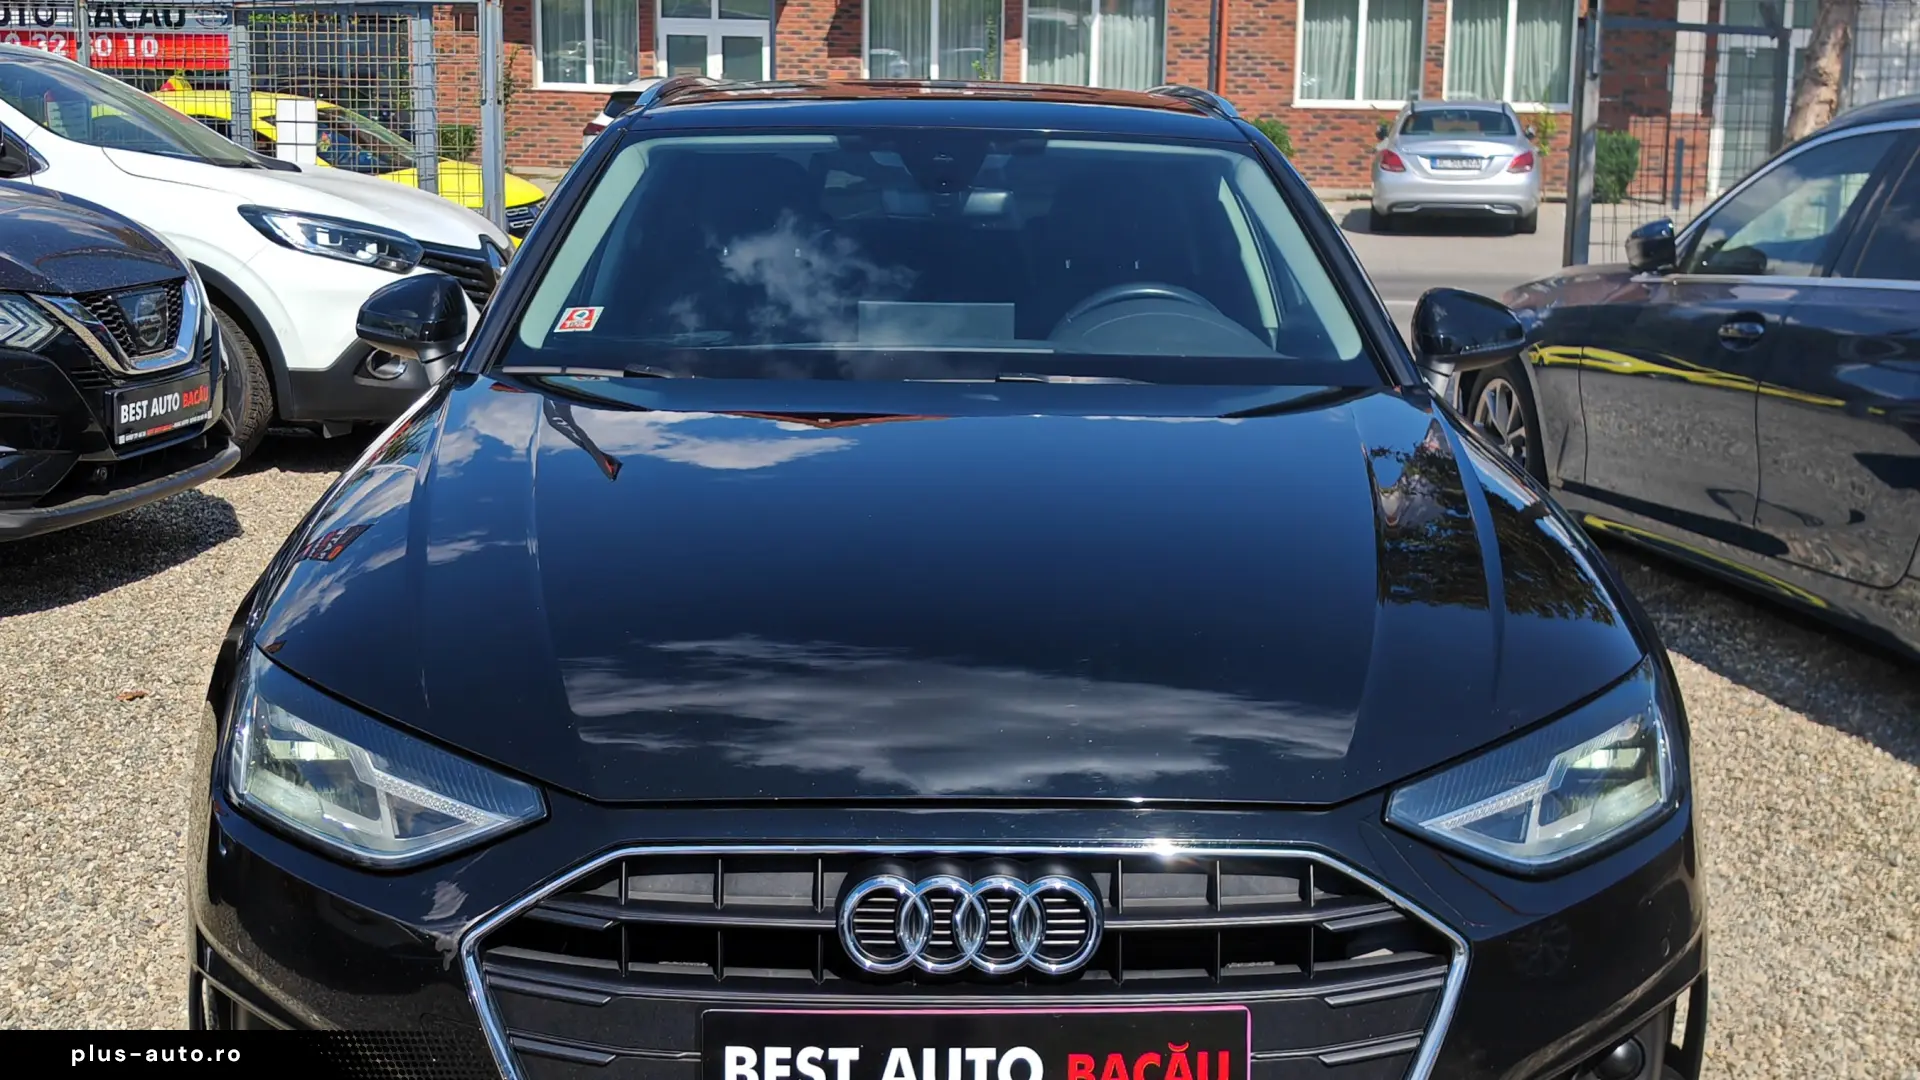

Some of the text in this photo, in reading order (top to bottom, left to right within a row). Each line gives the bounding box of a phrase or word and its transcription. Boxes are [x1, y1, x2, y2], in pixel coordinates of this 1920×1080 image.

[123, 35, 159, 57] 10
[121, 400, 148, 424] BEST
[150, 392, 180, 417] AUTO
[725, 1041, 1230, 1080] BEST AUTO BACĂU
